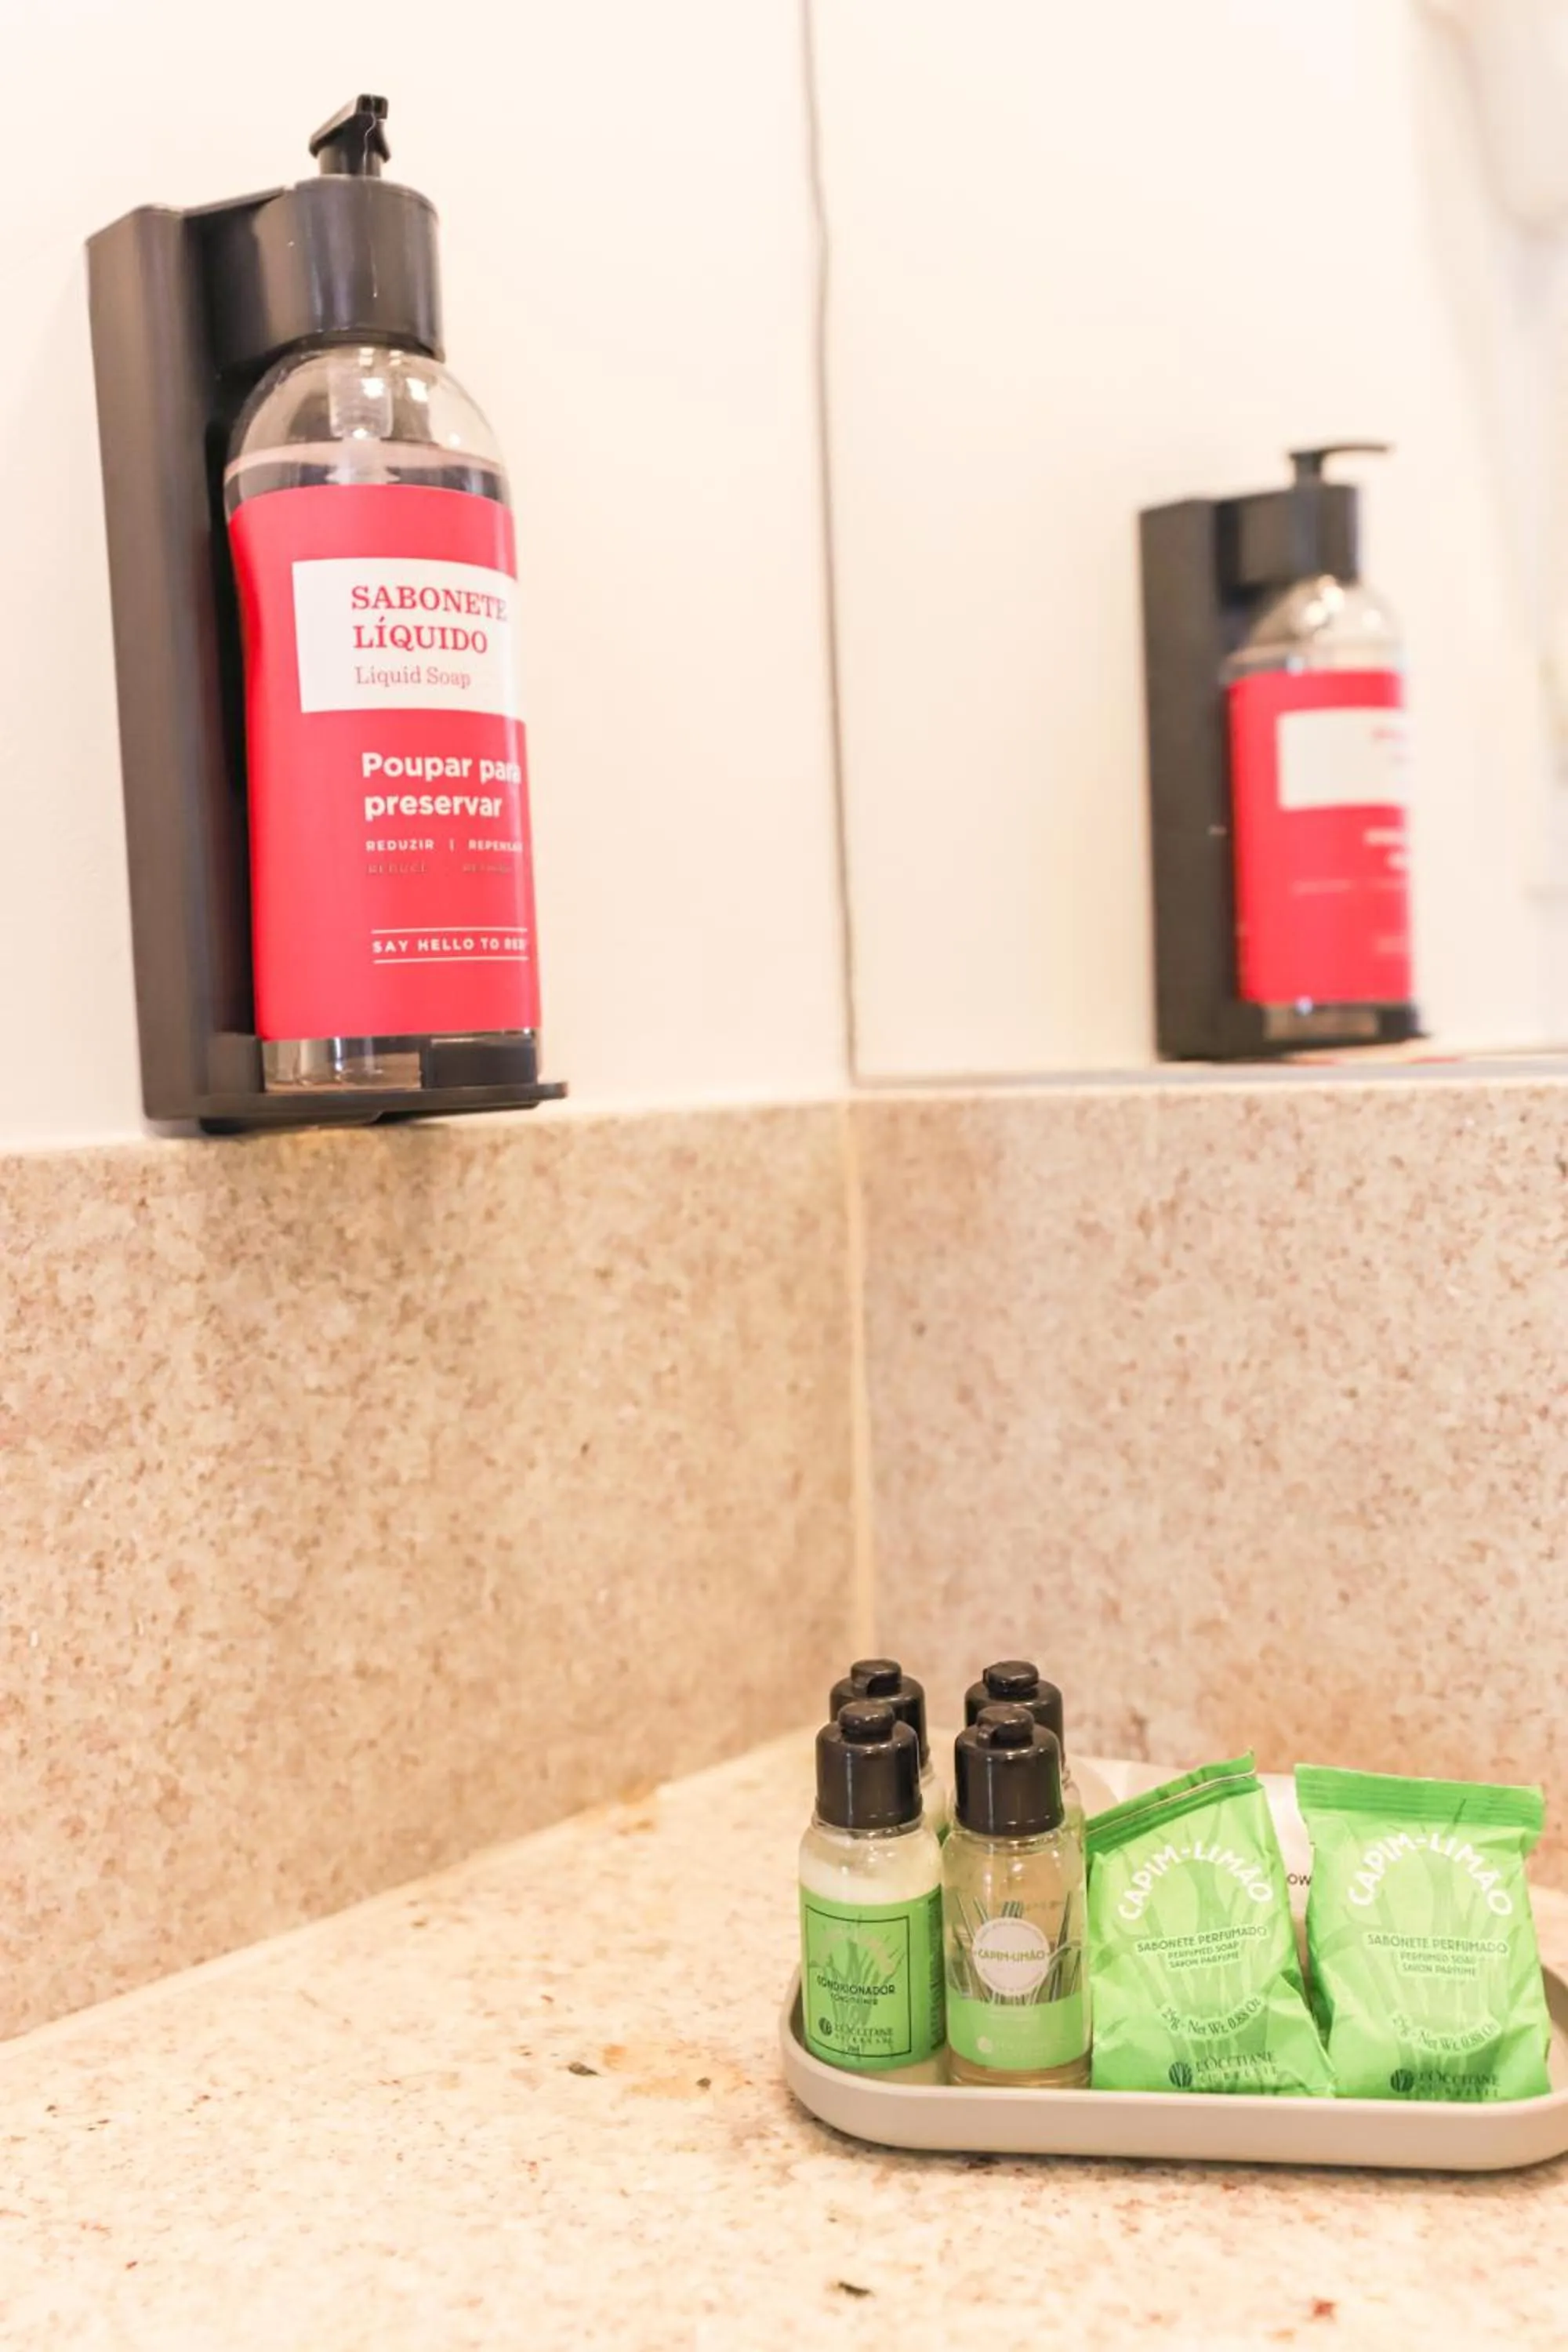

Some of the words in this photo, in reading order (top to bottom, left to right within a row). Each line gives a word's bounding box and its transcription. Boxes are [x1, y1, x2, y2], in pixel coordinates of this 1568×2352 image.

[351, 586, 508, 622] SABONETE
[353, 615, 488, 654] LÍQUIDO
[355, 666, 422, 688] Liquid
[426, 667, 471, 689] Soap
[361, 752, 473, 782] Poupar
[364, 794, 503, 822] preservar
[365, 838, 435, 852] REDUZIR
[372, 939, 409, 954] SAY
[417, 937, 475, 952] HELLO
[480, 937, 500, 951] TO
